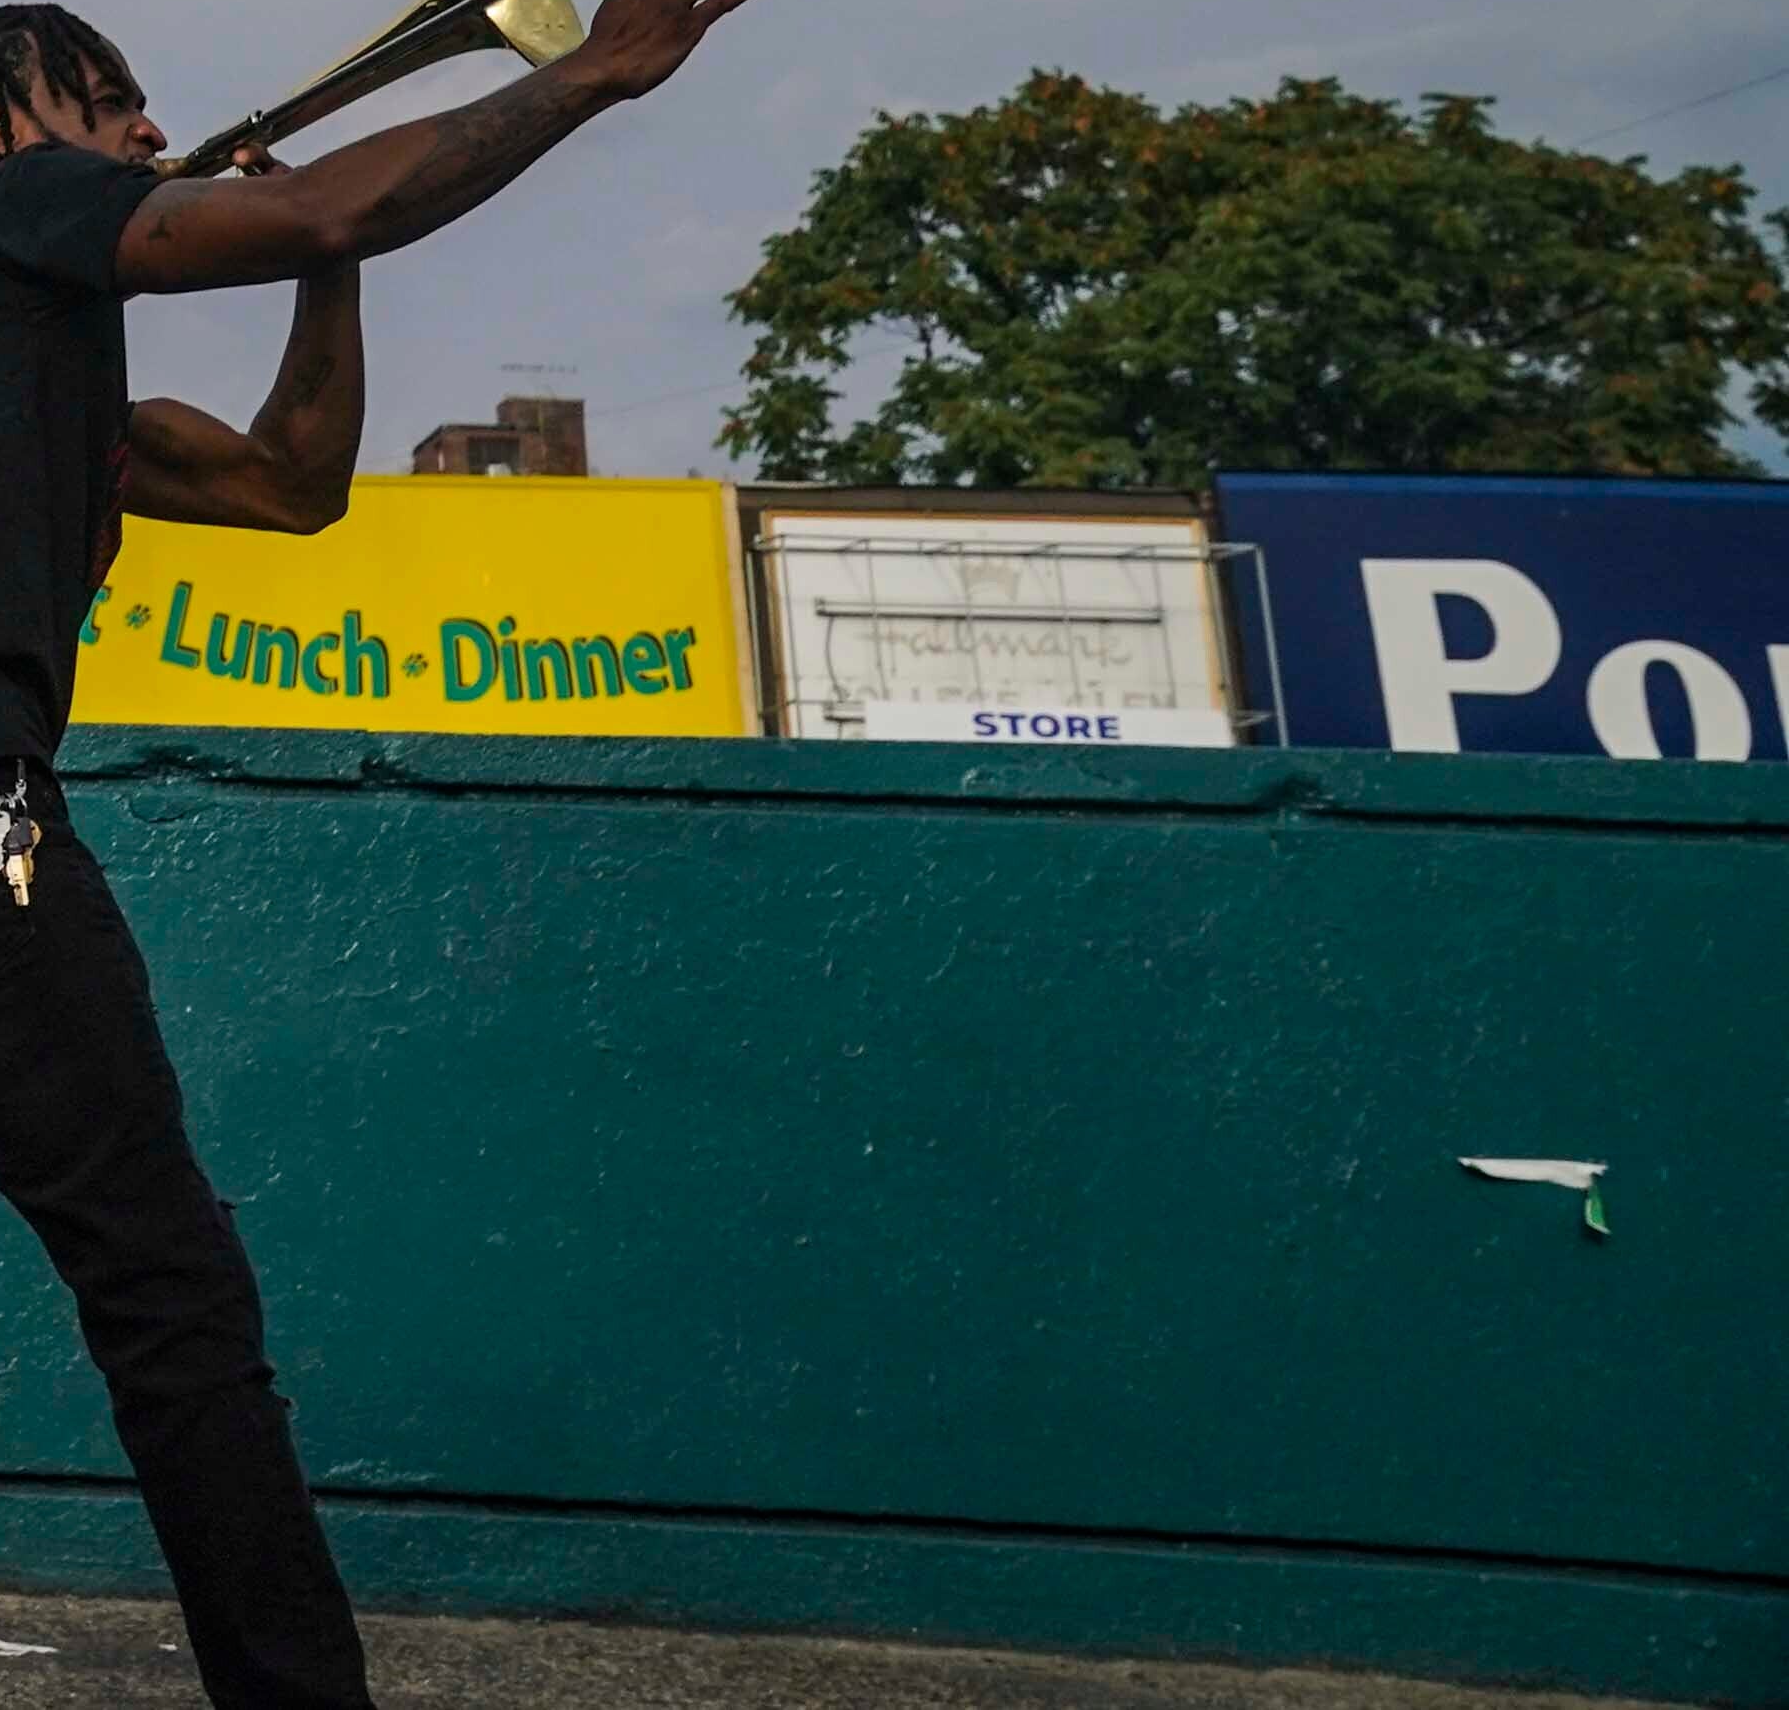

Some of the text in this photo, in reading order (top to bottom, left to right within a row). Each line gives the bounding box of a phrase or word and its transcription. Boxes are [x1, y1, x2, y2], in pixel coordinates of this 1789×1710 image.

[159, 580, 390, 699] Lunch
[439, 615, 695, 702] Dinner
[1359, 558, 1789, 763] Po
[971, 712, 1121, 740] STORE
